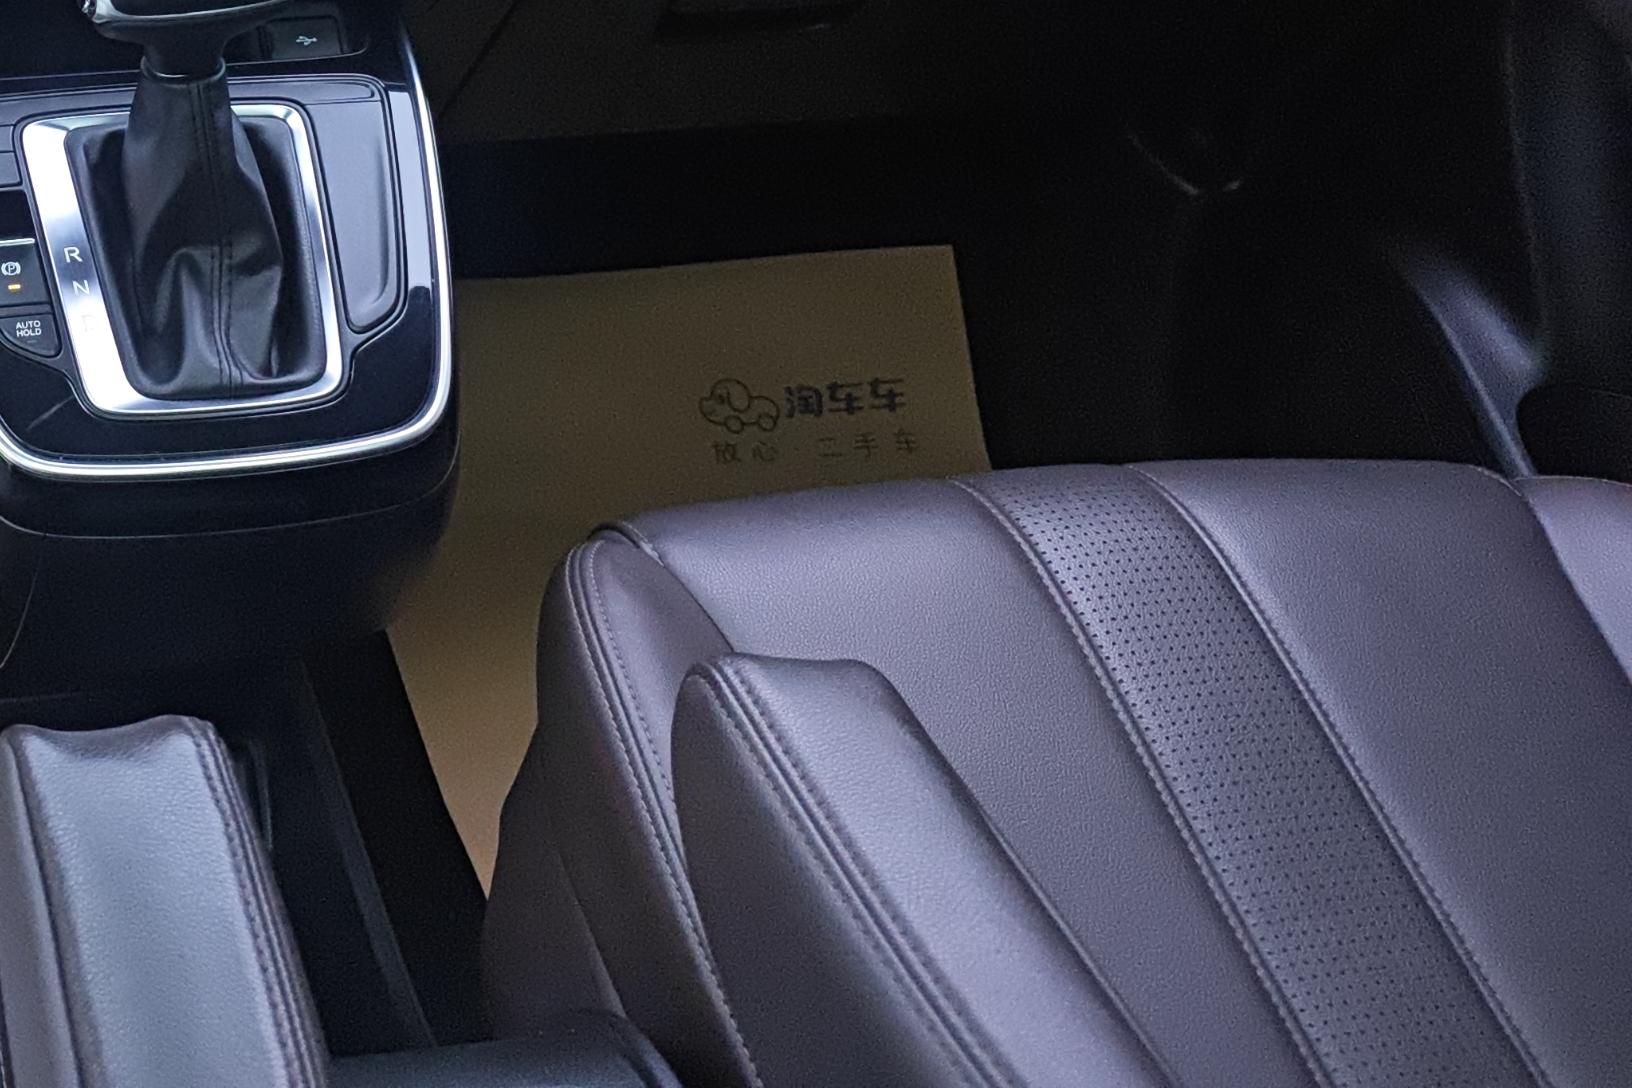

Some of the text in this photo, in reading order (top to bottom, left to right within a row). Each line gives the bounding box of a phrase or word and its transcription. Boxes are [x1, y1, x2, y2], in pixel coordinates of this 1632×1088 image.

[64, 247, 83, 263] R
[72, 280, 90, 295] N
[15, 320, 41, 329] AUTO
[16, 328, 42, 337] HOLD
[785, 376, 907, 419] 淘车车
